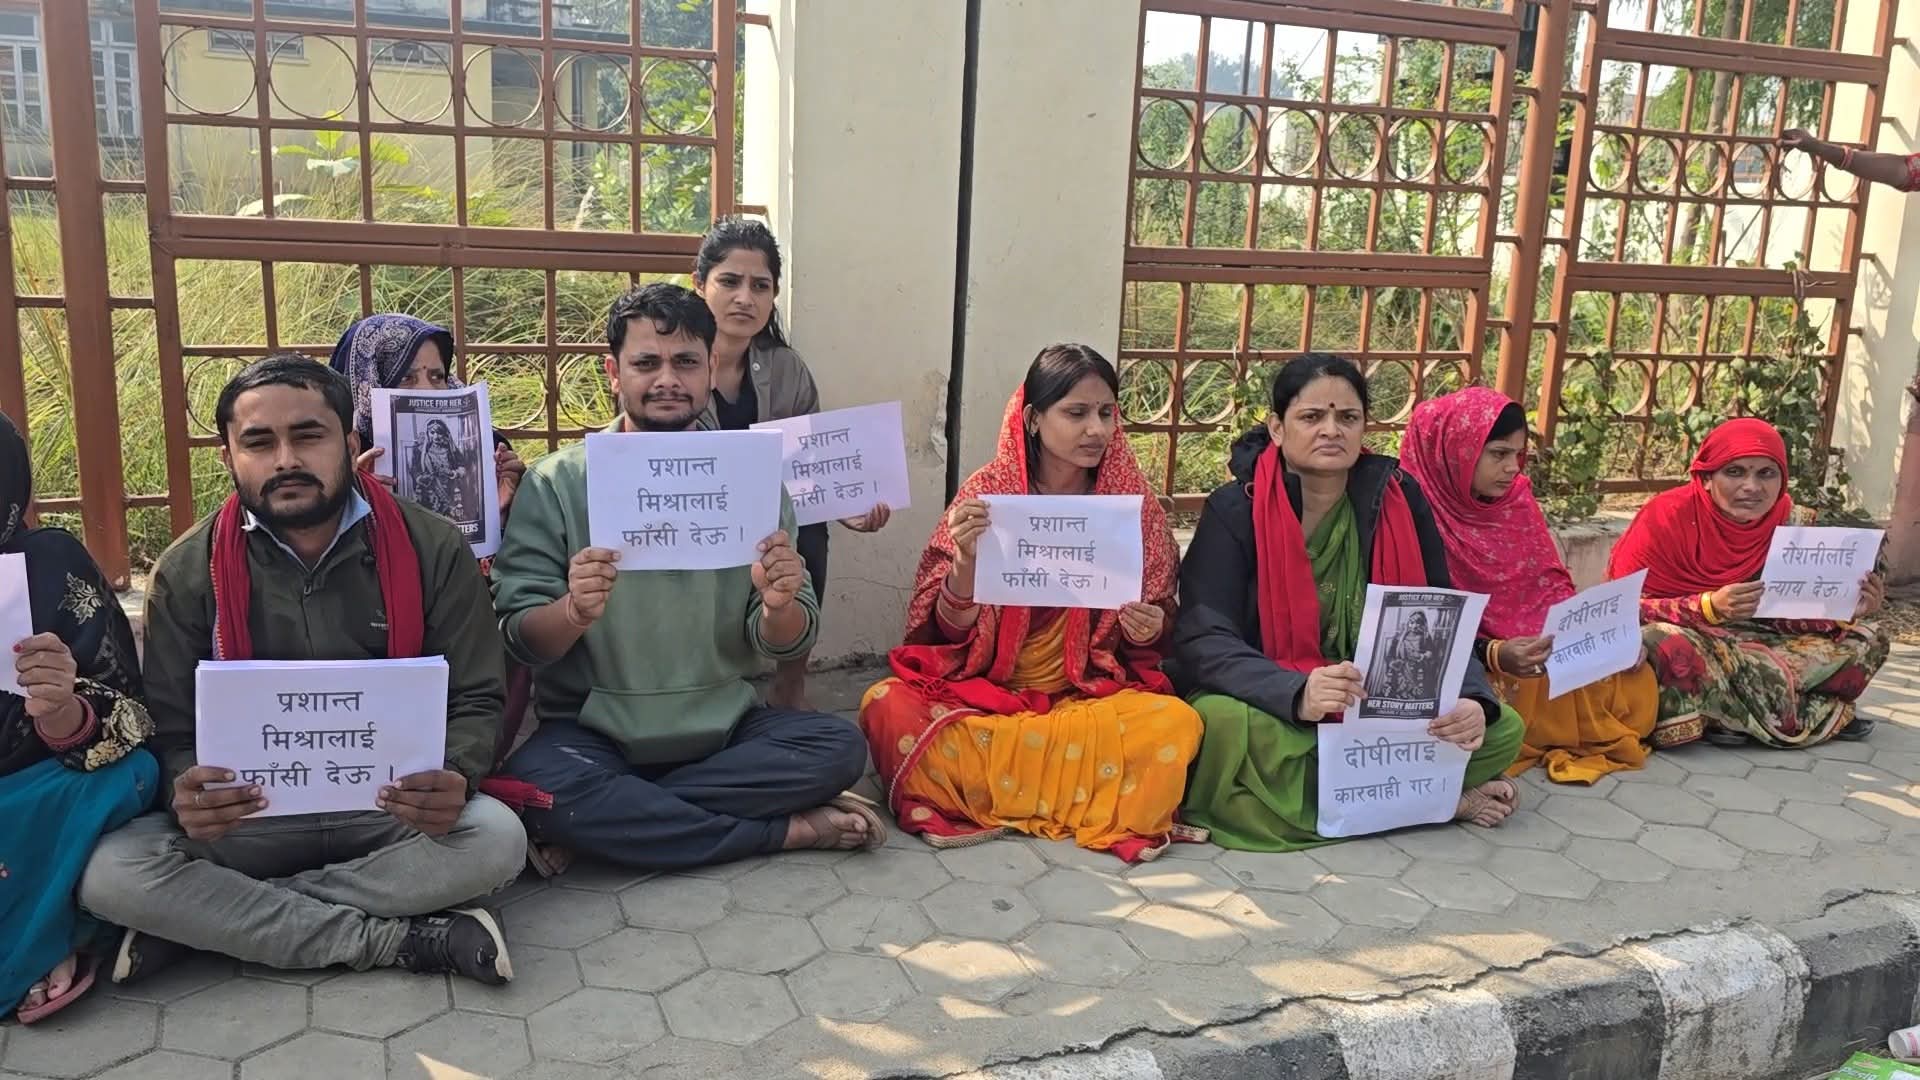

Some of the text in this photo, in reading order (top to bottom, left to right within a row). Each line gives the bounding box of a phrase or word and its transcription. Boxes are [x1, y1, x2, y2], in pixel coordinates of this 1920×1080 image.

[408, 399, 462, 408] JUSTICE FOR HER
[798, 428, 850, 450] प्रशान्त
[648, 457, 717, 477] प्रशान्त
[792, 449, 863, 480] मिश्रालाई
[637, 485, 728, 512] मिश्रालाई
[833, 481, 864, 500] देऊ
[456, 523, 479, 534] TERS
[622, 522, 679, 547] फाँसी
[689, 522, 728, 546] देऊ
[1029, 517, 1088, 532] प्रशान्त
[1017, 539, 1096, 564] मिश्रालाई
[1782, 541, 1857, 568] रोशनीलाई
[1002, 567, 1050, 587] फाँसी
[1059, 568, 1093, 589] देऊ
[1768, 581, 1807, 596] न्याय
[1812, 576, 1843, 598] देऊ
[277, 692, 364, 712] प्रशान्त
[1367, 699, 1434, 710] HER STORY MATTERS
[262, 721, 377, 751] मिश्रालाई
[239, 761, 311, 788] फाँसी
[325, 760, 375, 785] देऊ
[1334, 776, 1401, 804] कारवाही
[1409, 778, 1433, 795] गर
